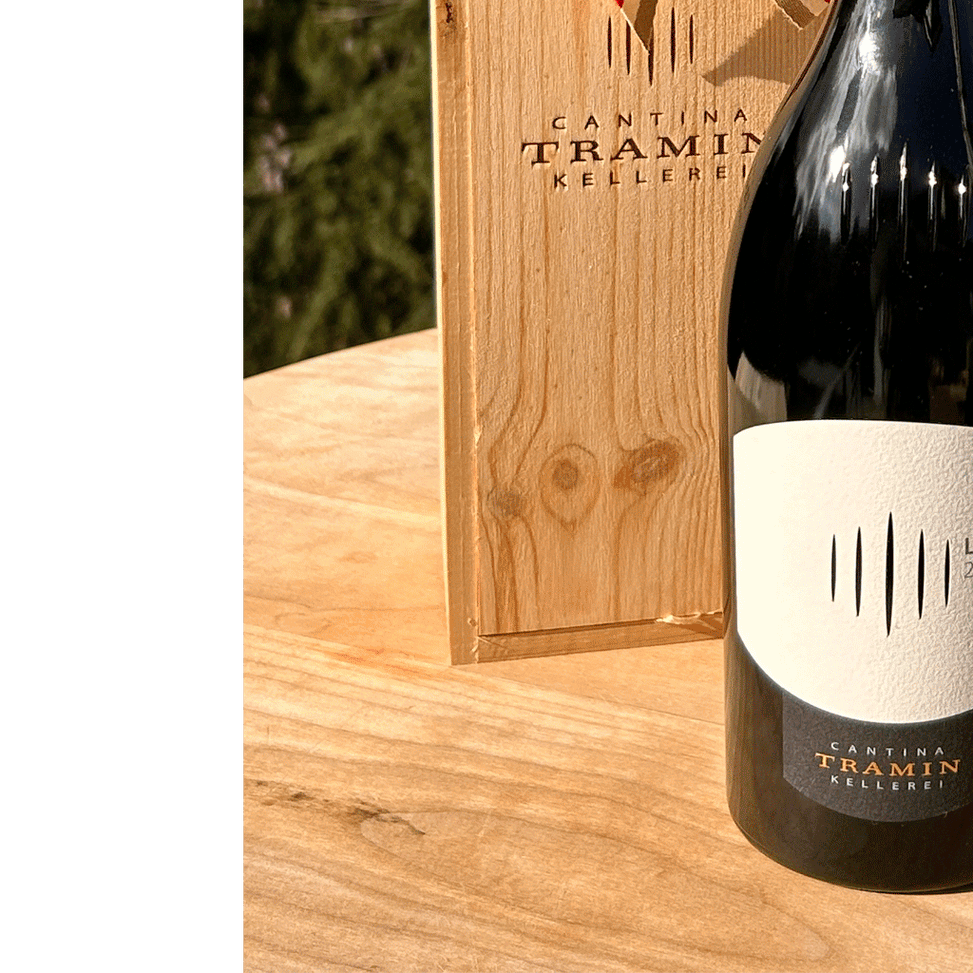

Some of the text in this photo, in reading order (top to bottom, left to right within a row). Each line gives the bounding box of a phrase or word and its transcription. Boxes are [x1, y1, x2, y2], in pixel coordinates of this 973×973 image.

[552, 109, 747, 130] CANTINA
[554, 163, 746, 189] KELLEREI
[830, 741, 944, 757] CANTINA
[814, 752, 961, 777] TRAMIN
[830, 774, 943, 791] KELLEREI
